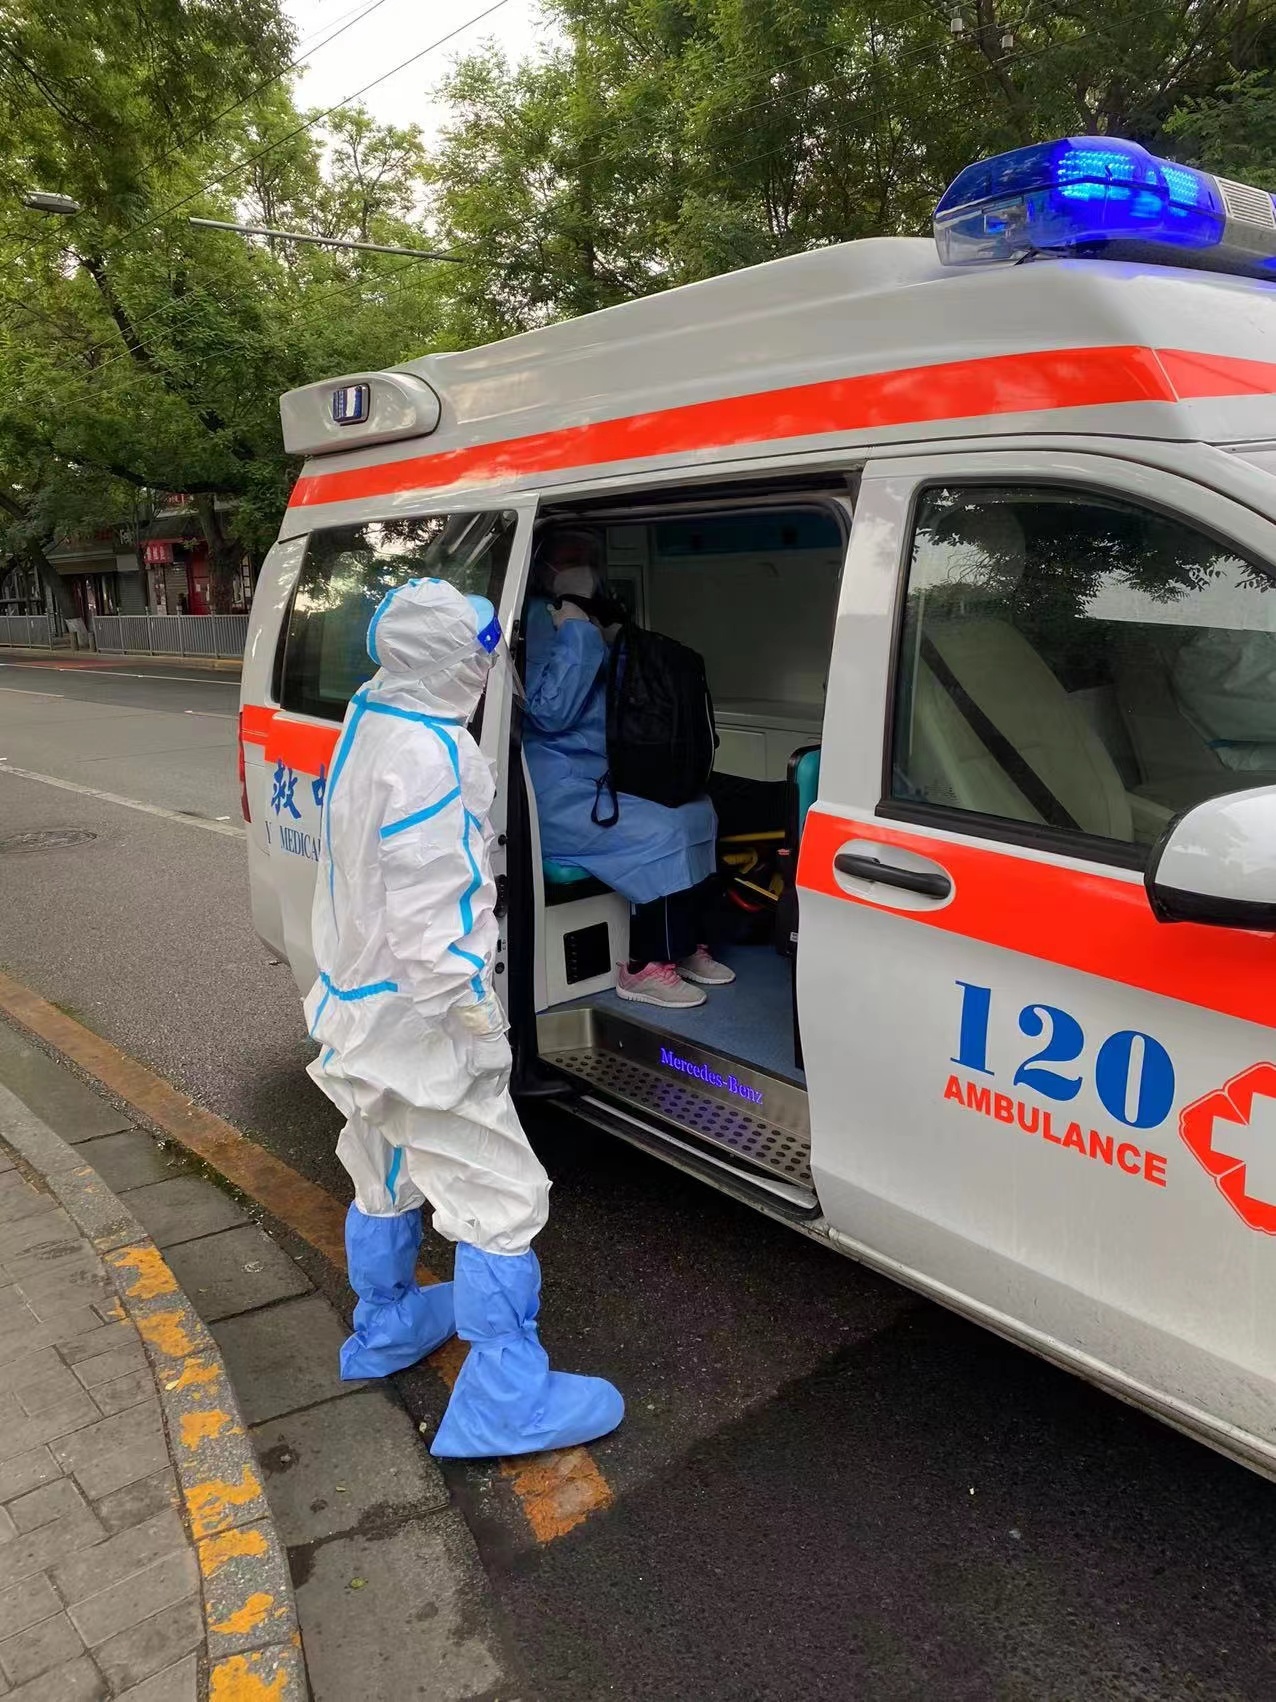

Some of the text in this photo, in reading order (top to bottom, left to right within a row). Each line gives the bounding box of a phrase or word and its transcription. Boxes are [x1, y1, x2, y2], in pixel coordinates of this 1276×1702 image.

[660, 1047, 763, 1105] Mercedes-Benz
[950, 980, 1175, 1129] 120
[944, 1075, 1167, 1187] AMBULANCE
